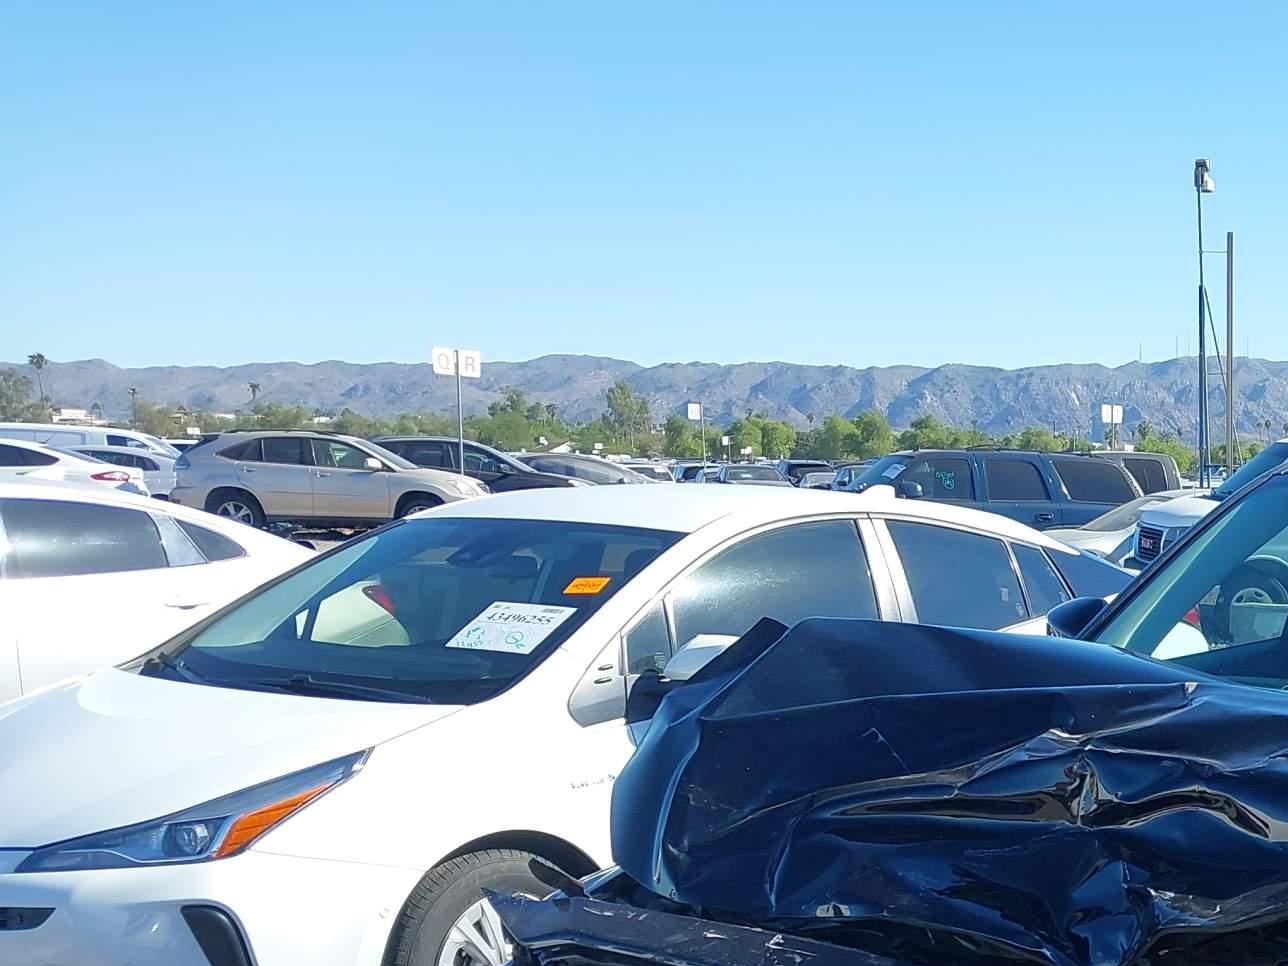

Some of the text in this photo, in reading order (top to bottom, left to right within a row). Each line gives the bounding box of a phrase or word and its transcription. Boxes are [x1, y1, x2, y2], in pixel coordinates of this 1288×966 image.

[437, 351, 450, 371] Q
[464, 355, 476, 373] R
[486, 611, 556, 626] 43496255
